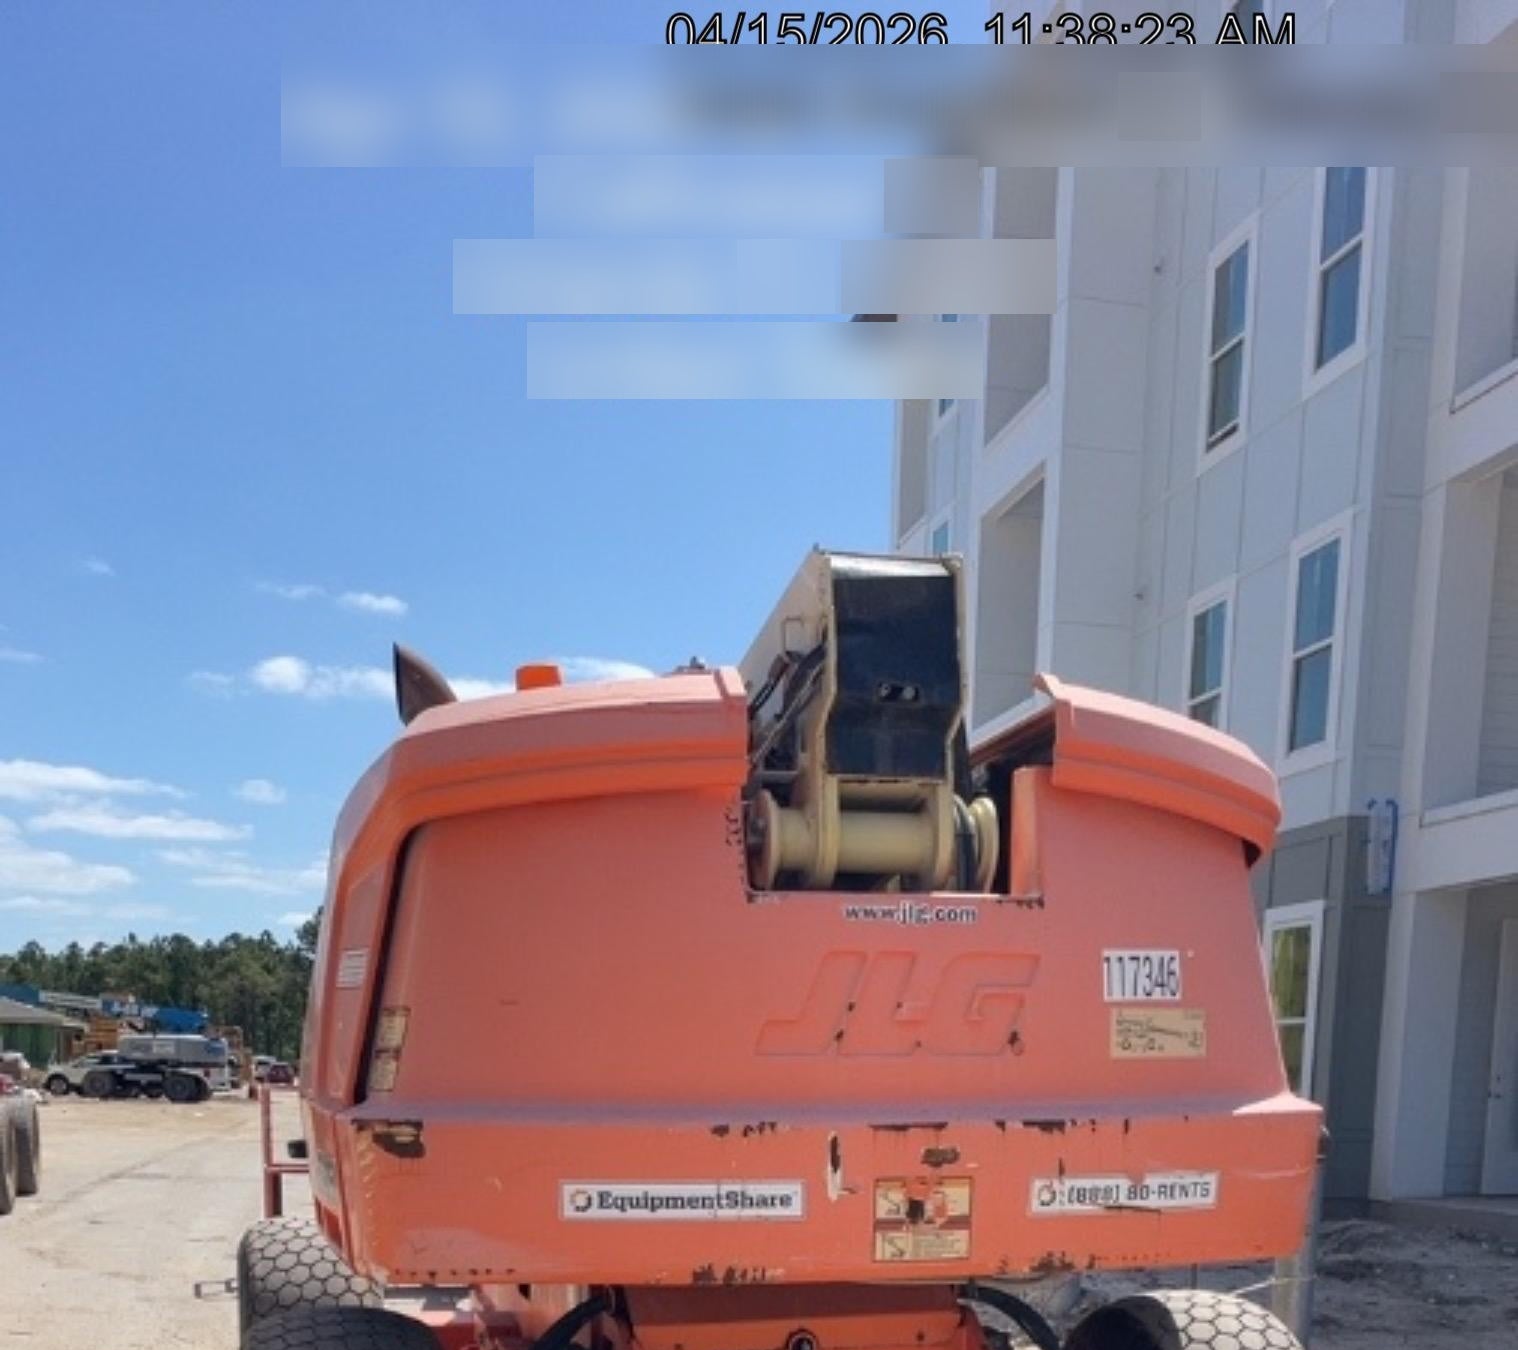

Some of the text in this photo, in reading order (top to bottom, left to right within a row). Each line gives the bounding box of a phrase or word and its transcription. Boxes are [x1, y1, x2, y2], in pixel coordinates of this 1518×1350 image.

[844, 902, 978, 925] www.jlg.com
[1103, 955, 1179, 998] 117346
[753, 948, 1041, 1056] JLG
[596, 1190, 794, 1213] EquipmentShare
